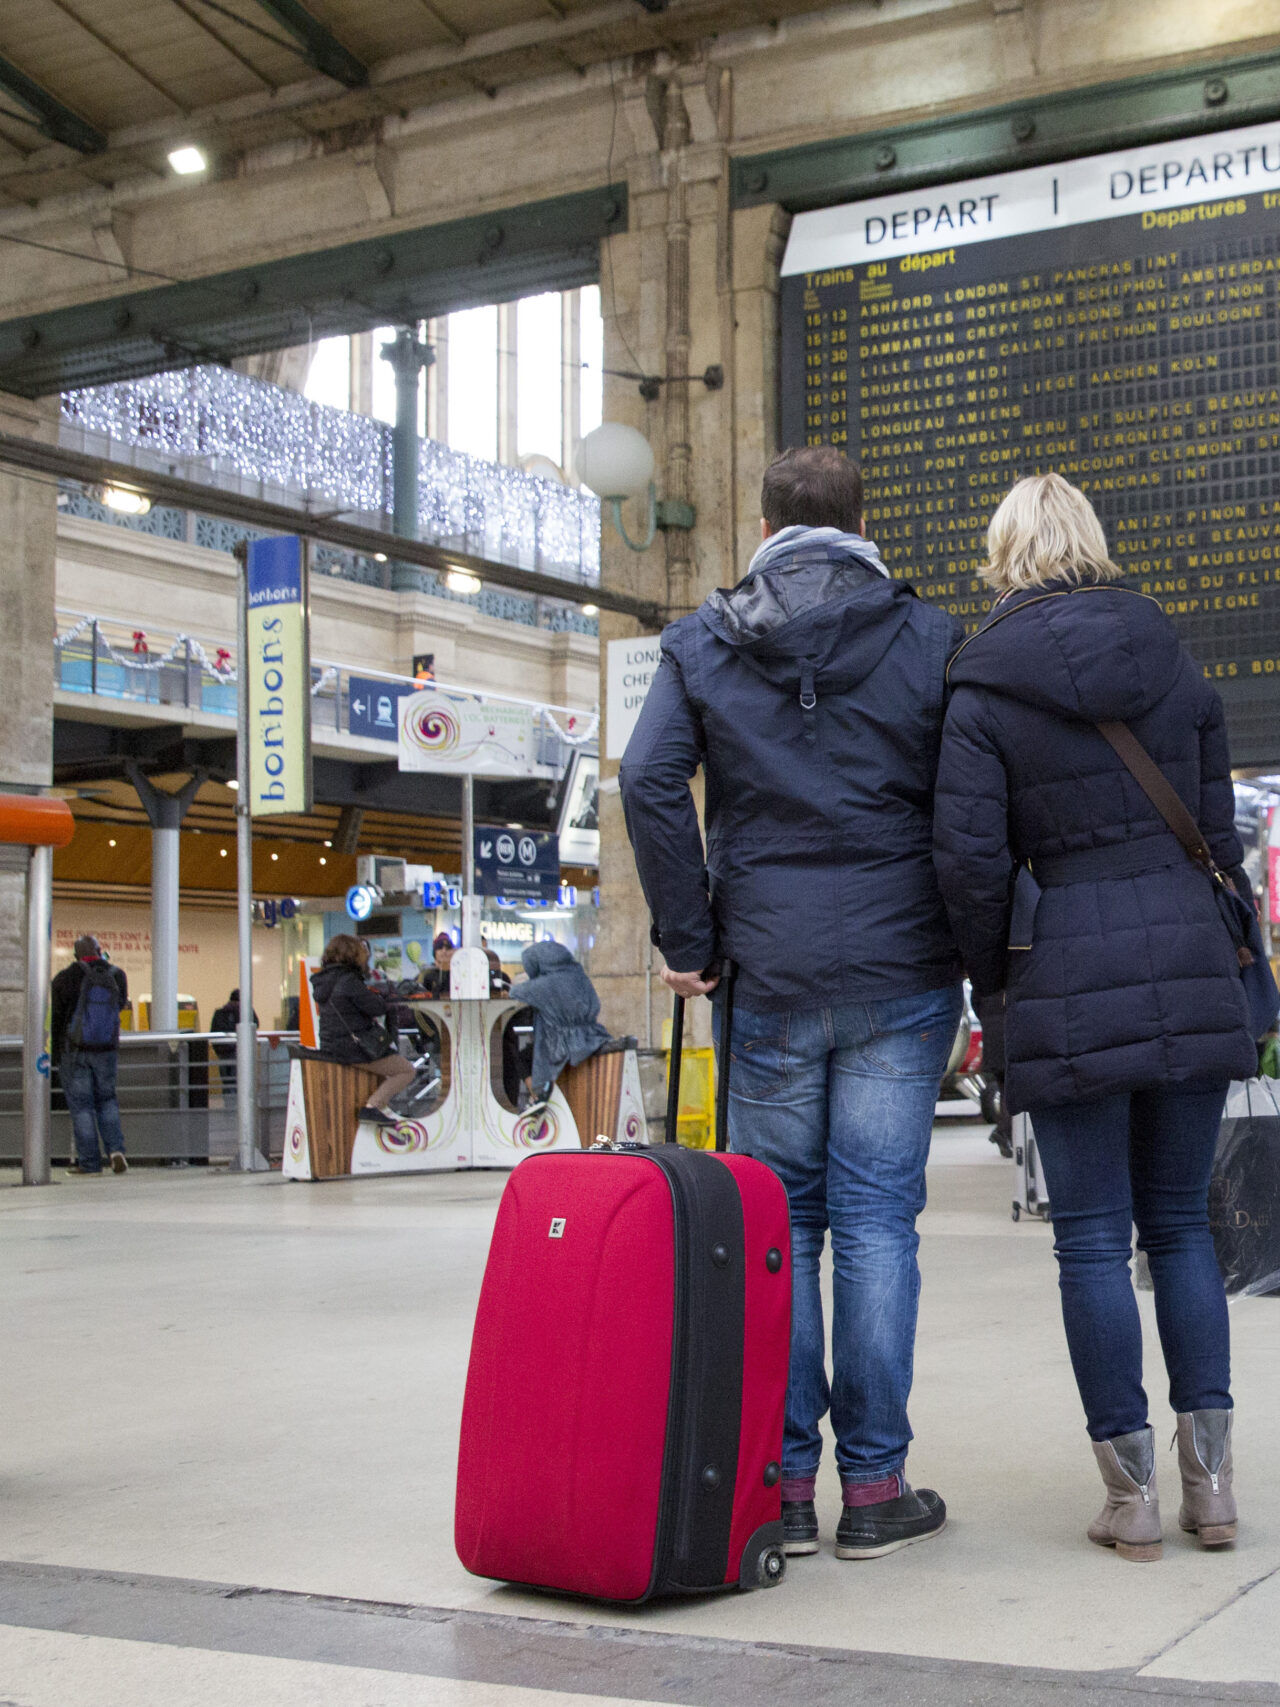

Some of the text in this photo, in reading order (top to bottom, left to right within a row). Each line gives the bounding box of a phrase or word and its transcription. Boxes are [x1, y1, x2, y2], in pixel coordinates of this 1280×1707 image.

[805, 269, 855, 289] Trains
[866, 263, 887, 280] au
[899, 248, 956, 272] départ
[1142, 199, 1247, 229] Departures
[864, 195, 1000, 246] DEPART
[860, 294, 932, 317] ASHFORD
[945, 283, 1008, 303] LONDON
[1054, 260, 1132, 282] PANCRAS
[1147, 252, 1177, 268] INT
[860, 312, 954, 338] BRUXELLES
[966, 293, 1064, 319] ROTTERDAM
[1077, 277, 1165, 301] SCHIPHOL
[859, 332, 954, 359] DAMMARTIN
[966, 322, 1018, 341] CREPY
[1033, 305, 1121, 330] SOISSONS
[861, 359, 909, 378] LILLE
[924, 347, 985, 368] EUROPE
[999, 335, 1064, 356] CALAIS
[1078, 320, 1157, 342] FRETHUN
[1023, 375, 1075, 394] LIEGE
[1091, 364, 1158, 383] AACHEN
[1171, 356, 1217, 371] KOLN
[861, 416, 944, 439] LONGUEAU
[957, 405, 1020, 424] AMIENS
[861, 440, 923, 458] PERSAN
[936, 428, 1009, 449] CHAMBLY
[1023, 421, 1066, 436] MERU
[861, 464, 910, 479] CREIL
[925, 454, 965, 470] PONT
[979, 439, 1076, 464] COMPIEGNE
[1093, 425, 1182, 447] TERGNIER
[864, 478, 954, 500] CHANTILLY
[1149, 439, 1242, 462] CLERMONT
[862, 498, 954, 522] EBBSFLEET
[969, 491, 1008, 508] LON
[1081, 472, 1160, 493] PANCRAS
[1176, 465, 1206, 480] INT
[874, 524, 911, 539] ILLE
[883, 546, 912, 560] EPY
[893, 565, 934, 579] MBLY
[1117, 533, 1195, 554] SULPICE
[1165, 593, 1258, 615] OMPIEGNE
[623, 673, 655, 688] CHE
[1203, 663, 1237, 678] LES
[259, 617, 285, 801] bonbons
